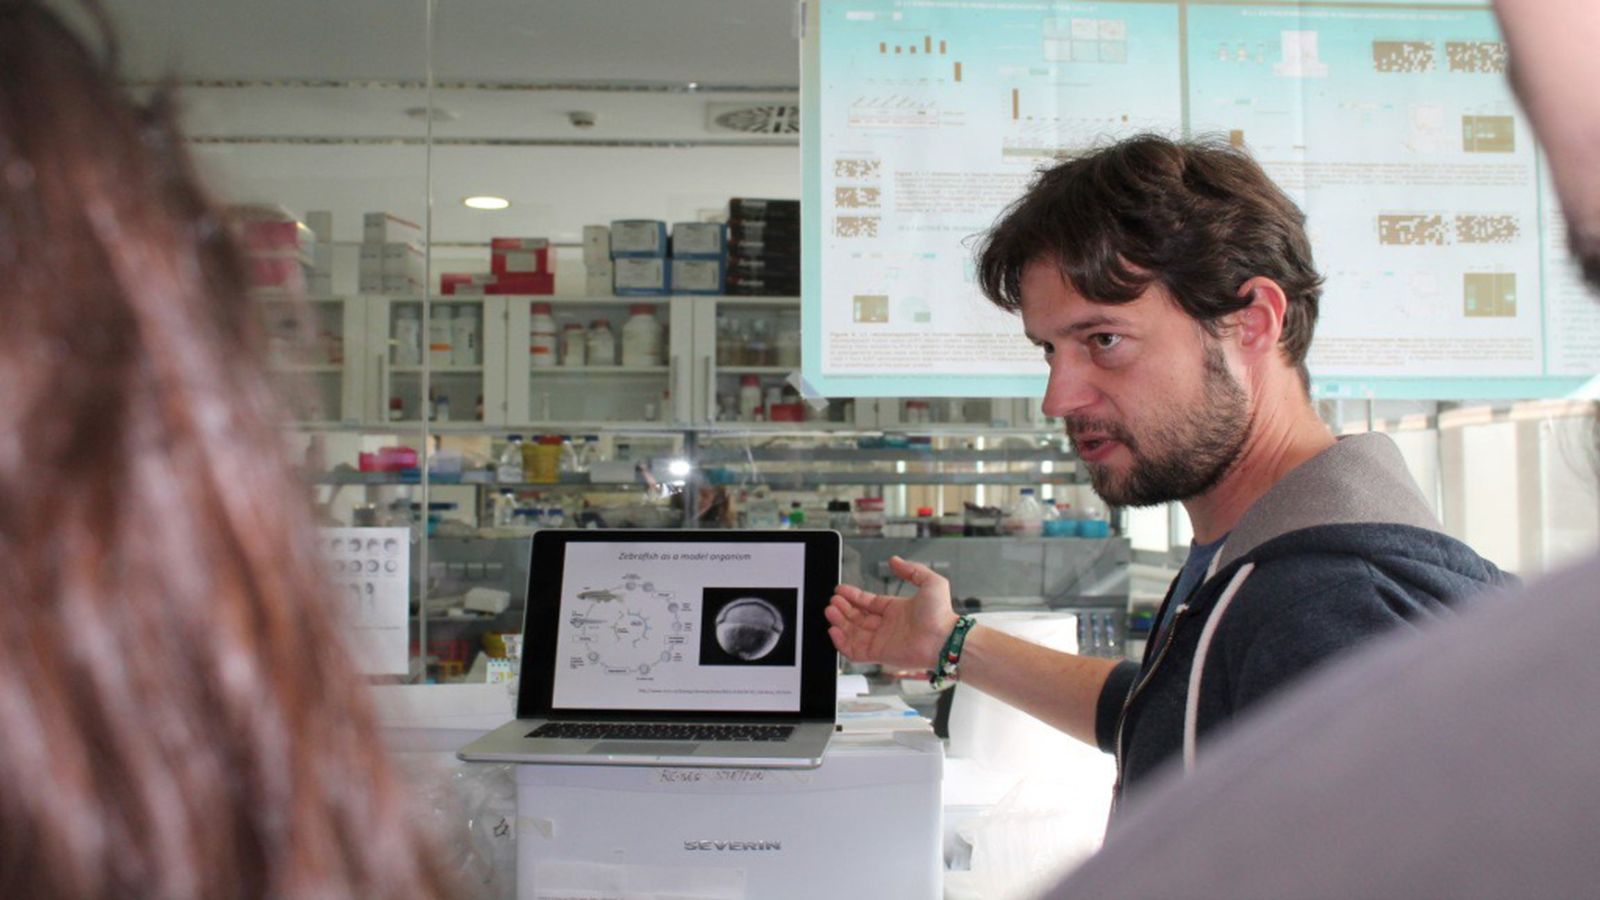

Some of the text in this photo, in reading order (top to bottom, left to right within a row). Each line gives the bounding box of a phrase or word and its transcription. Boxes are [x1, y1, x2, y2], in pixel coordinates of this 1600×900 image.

[618, 551, 751, 563] Zebrafish as a model organism
[684, 839, 782, 852] SEVERIN
